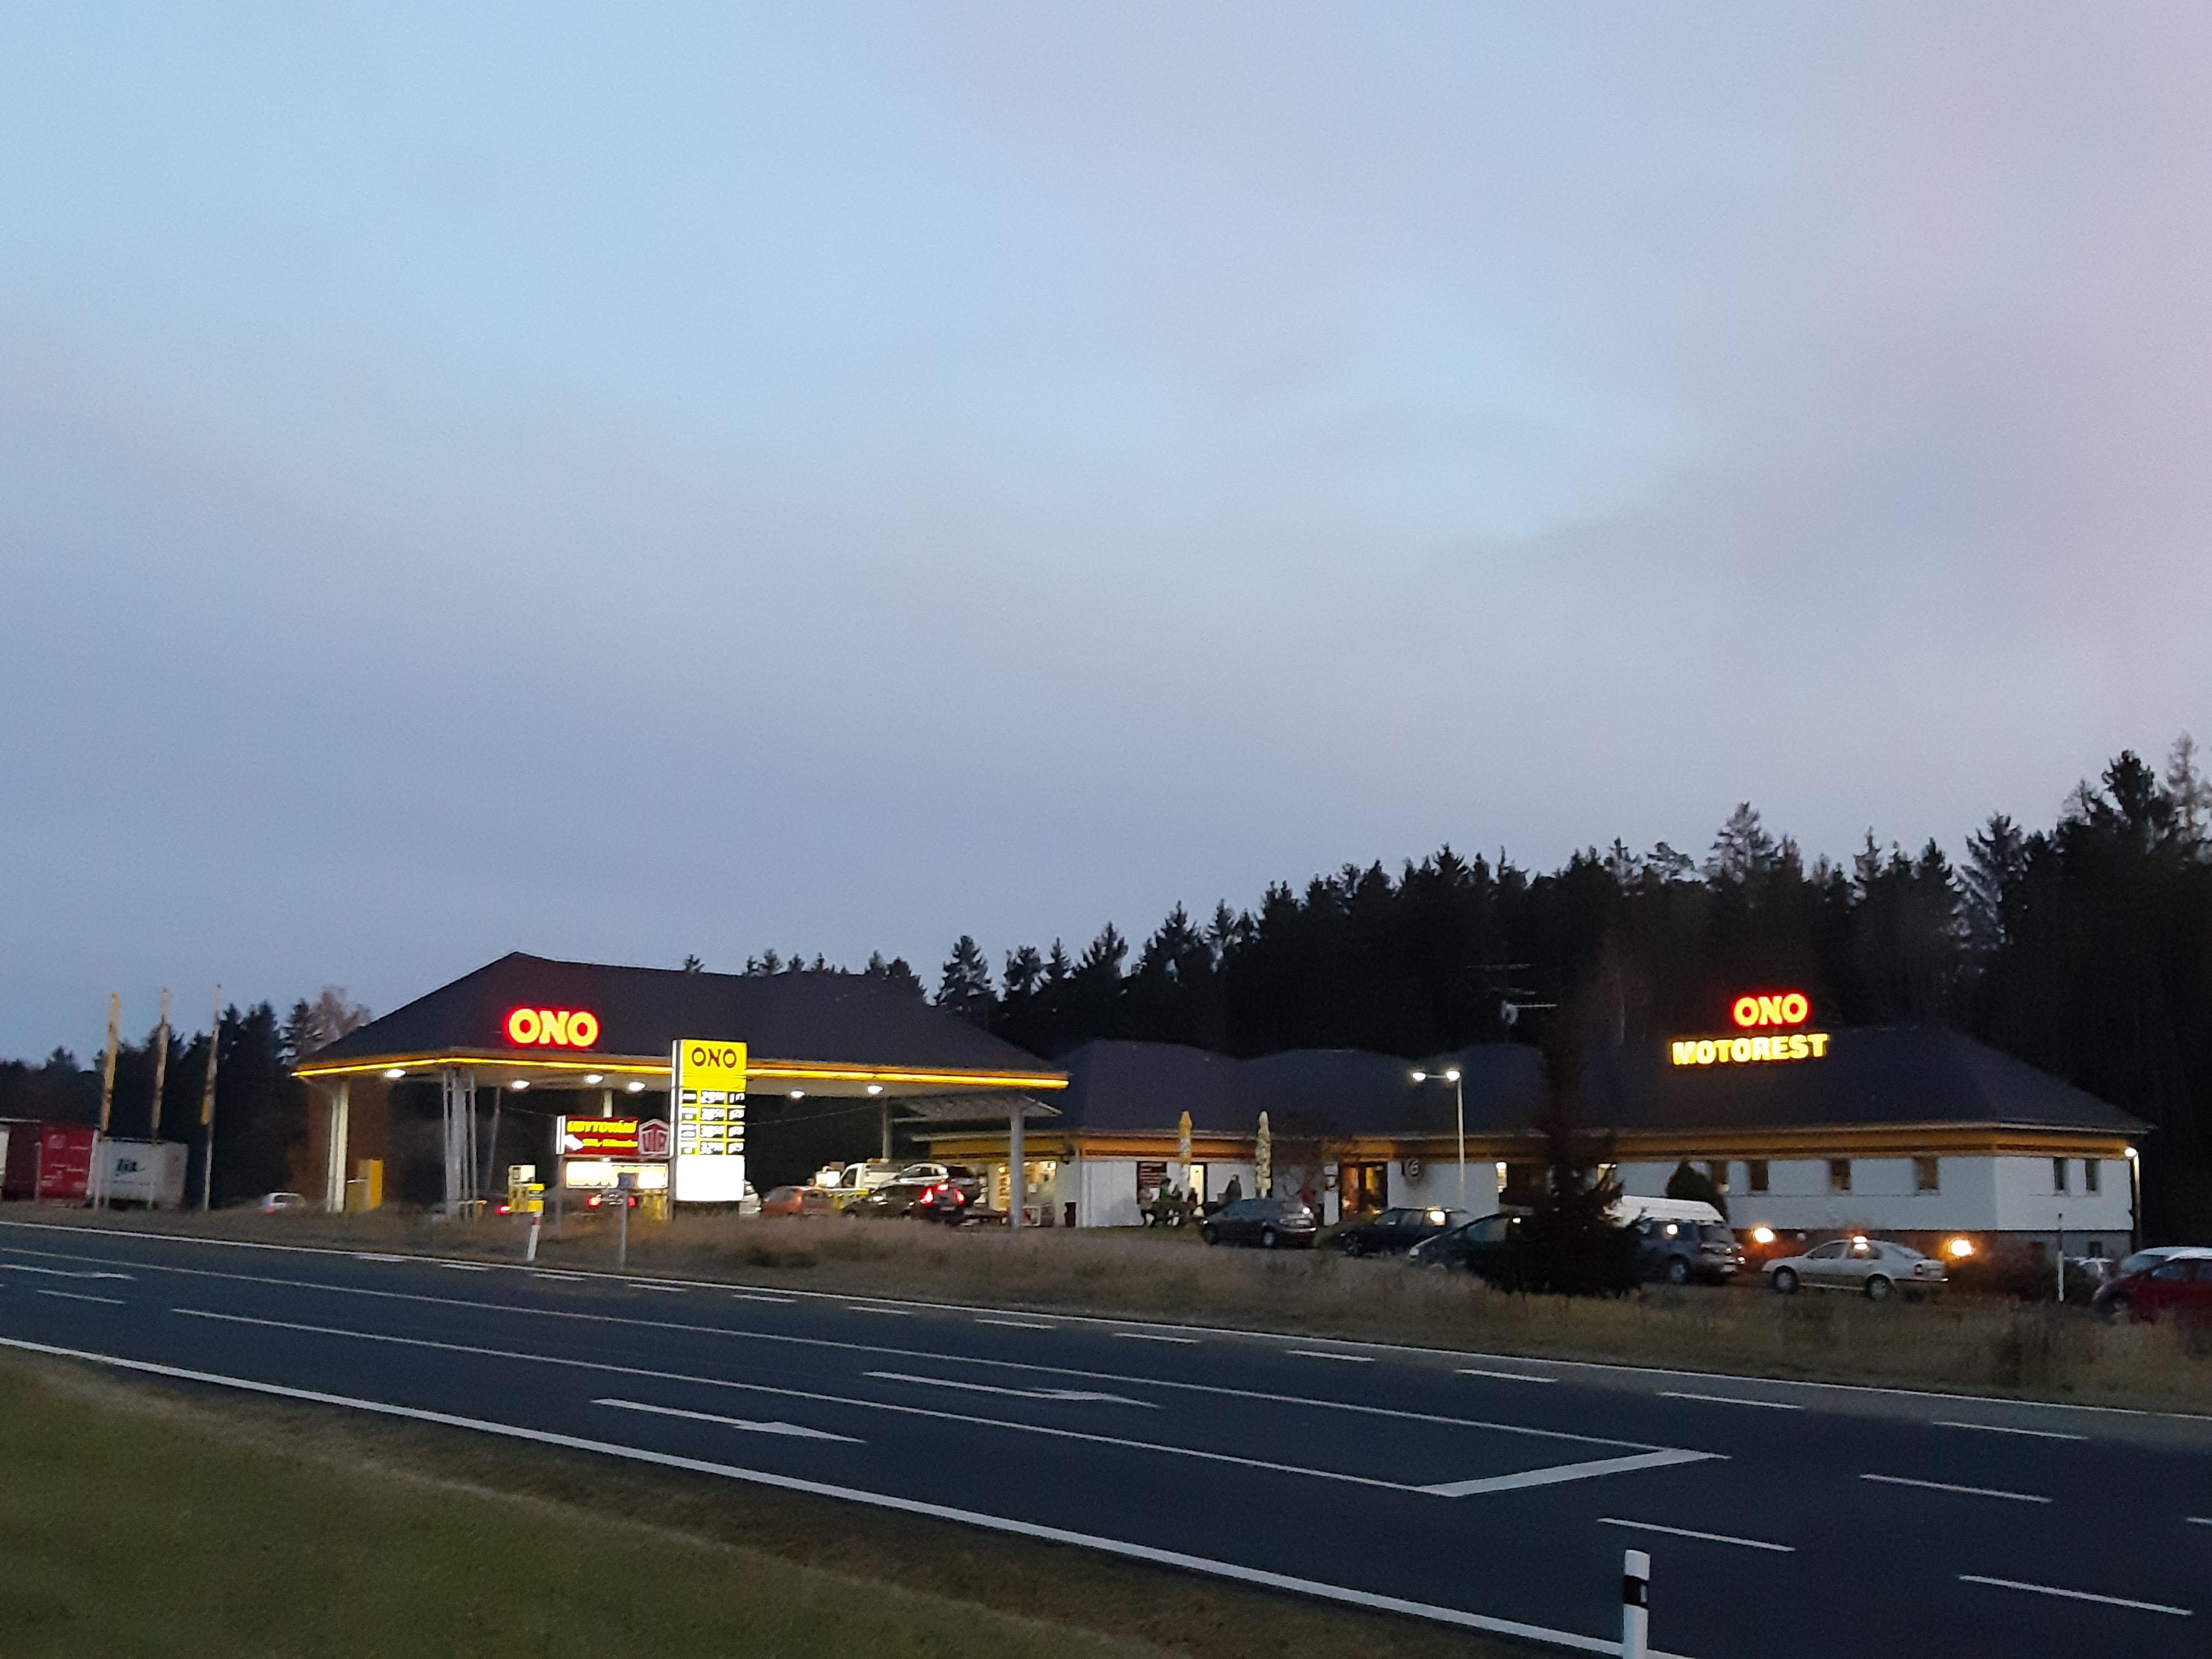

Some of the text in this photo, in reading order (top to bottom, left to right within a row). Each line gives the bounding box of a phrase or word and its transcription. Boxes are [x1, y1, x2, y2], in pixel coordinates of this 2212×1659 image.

[1734, 994, 1808, 1026] ONO
[509, 1009, 598, 1046] ONO
[692, 1047, 737, 1068] ONO
[1672, 1034, 1828, 1065] MOTOREST
